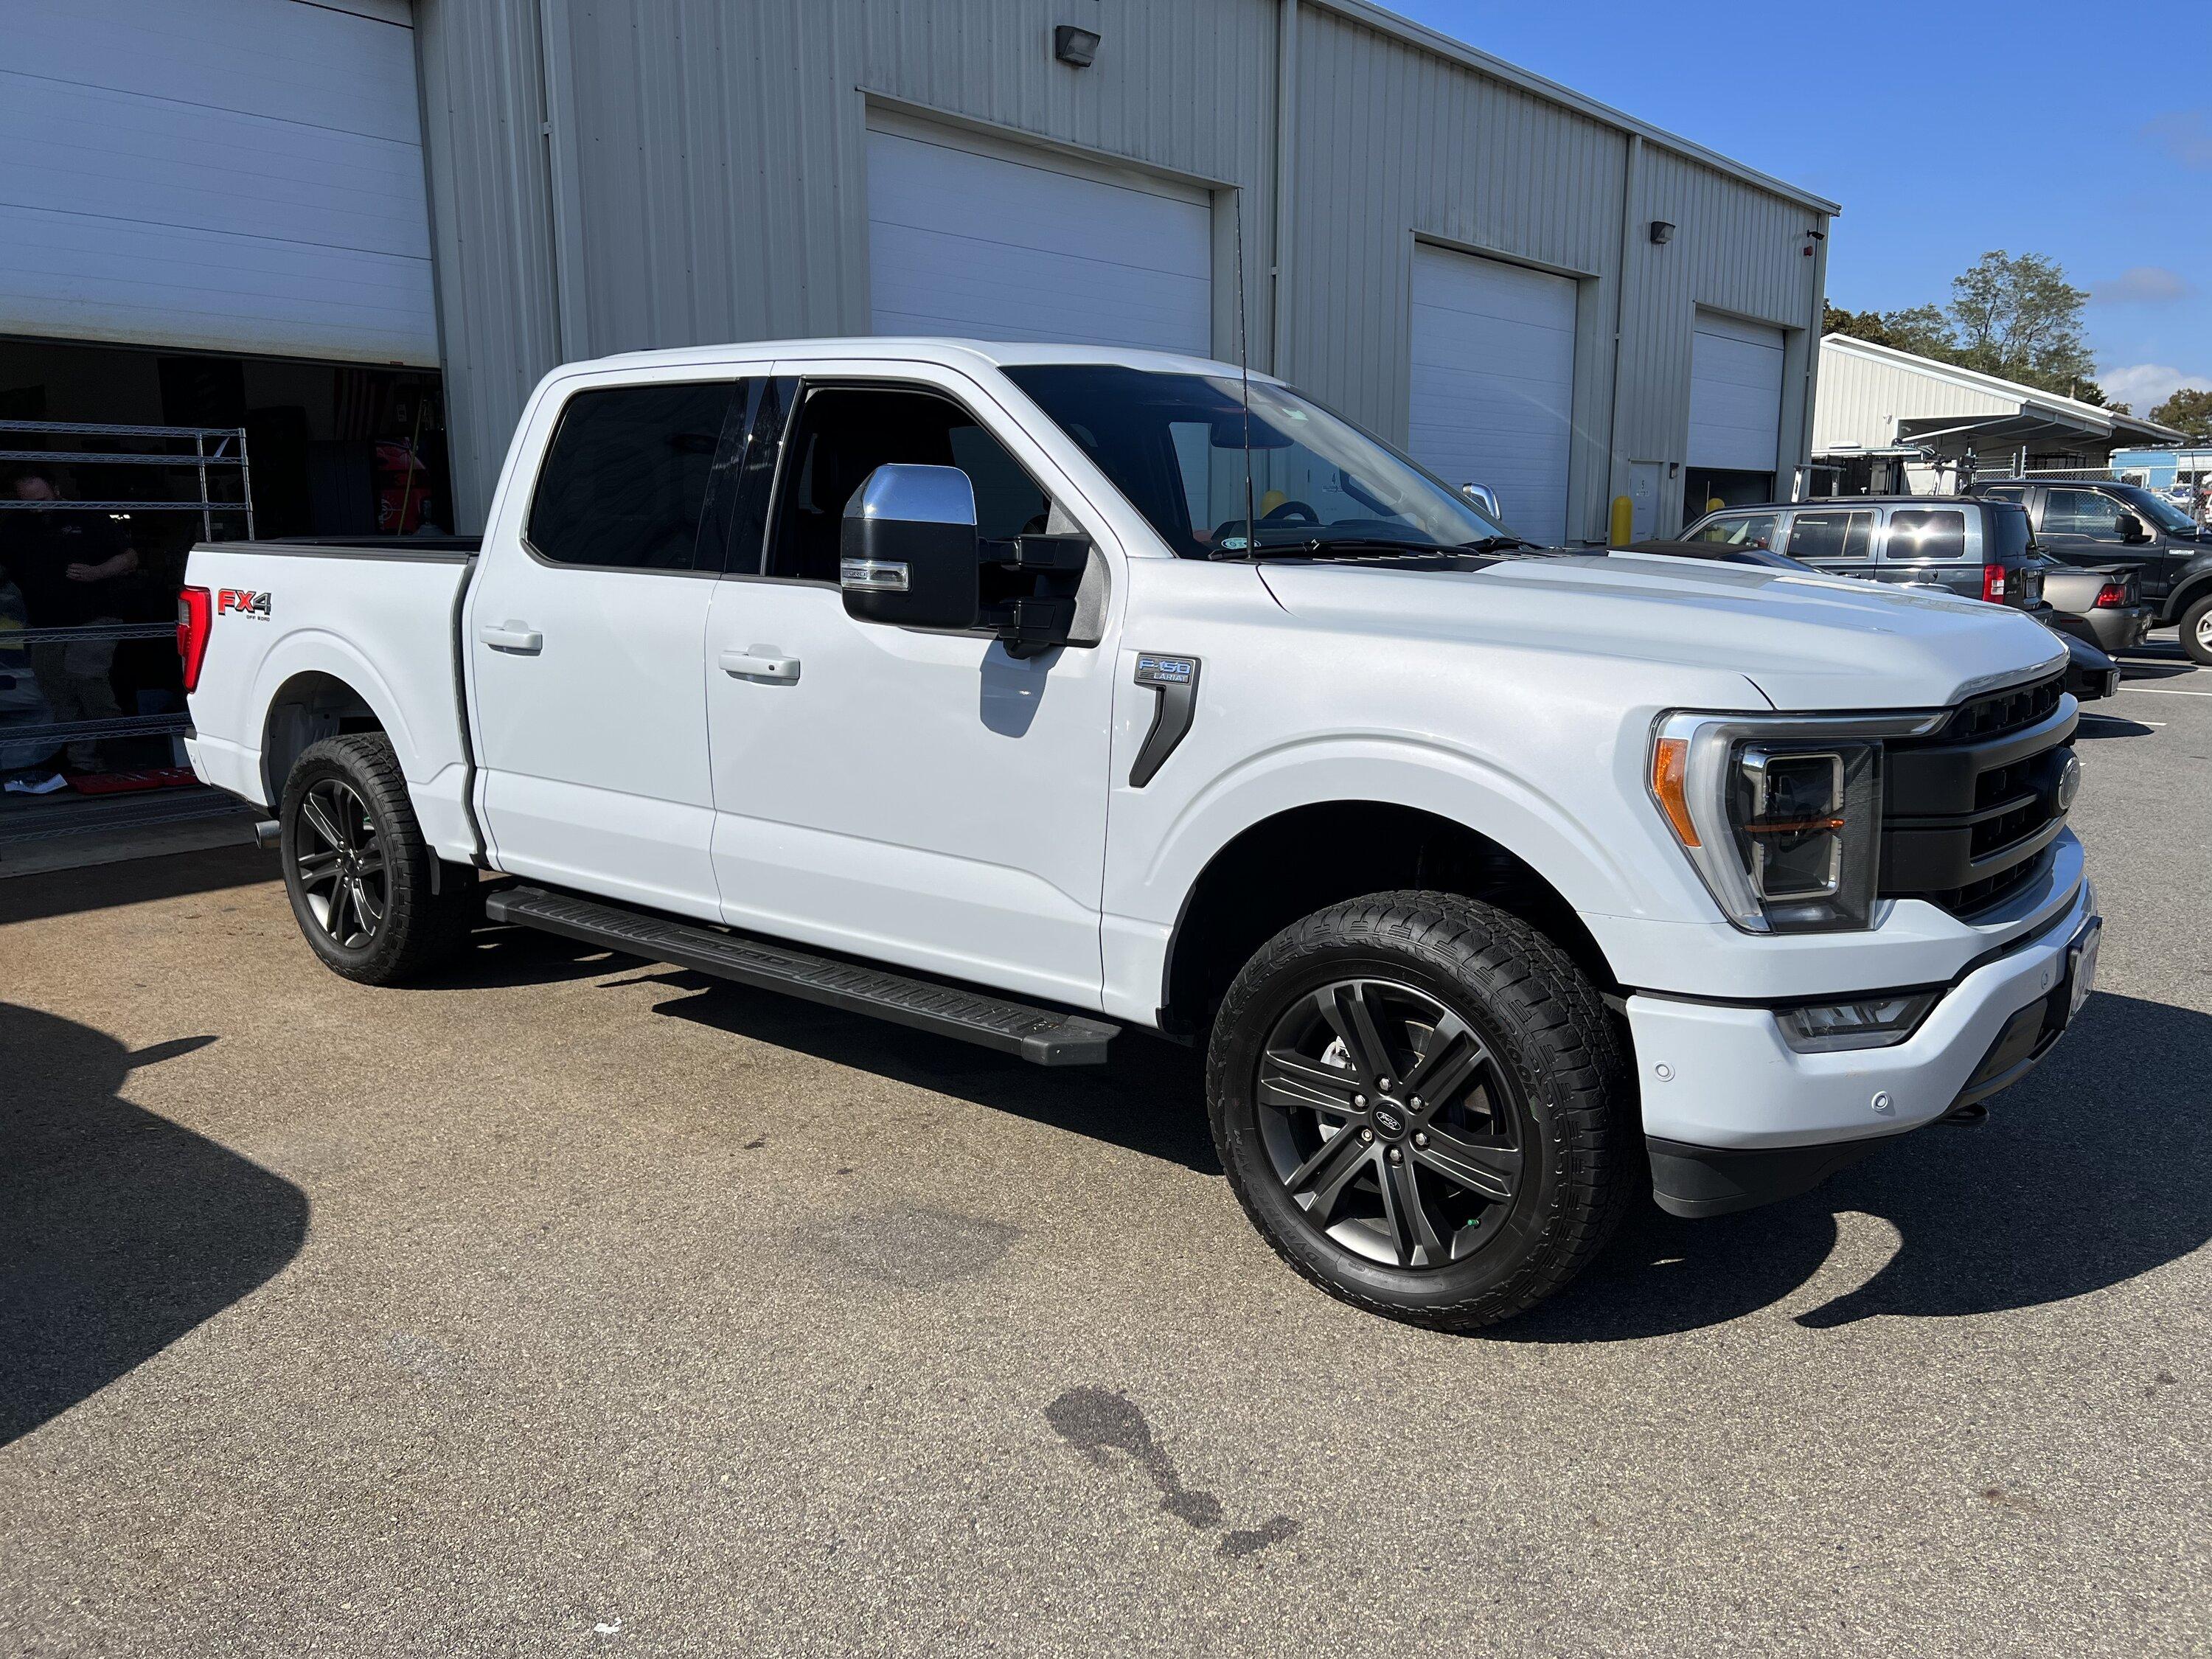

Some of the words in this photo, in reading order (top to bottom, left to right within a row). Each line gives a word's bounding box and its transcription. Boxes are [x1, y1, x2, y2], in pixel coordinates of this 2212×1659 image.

[218, 588, 271, 615] FX4
[1139, 658, 1192, 675] F-150
[1153, 672, 1186, 683] LARIAT
[1380, 1113, 1397, 1127] Ford
